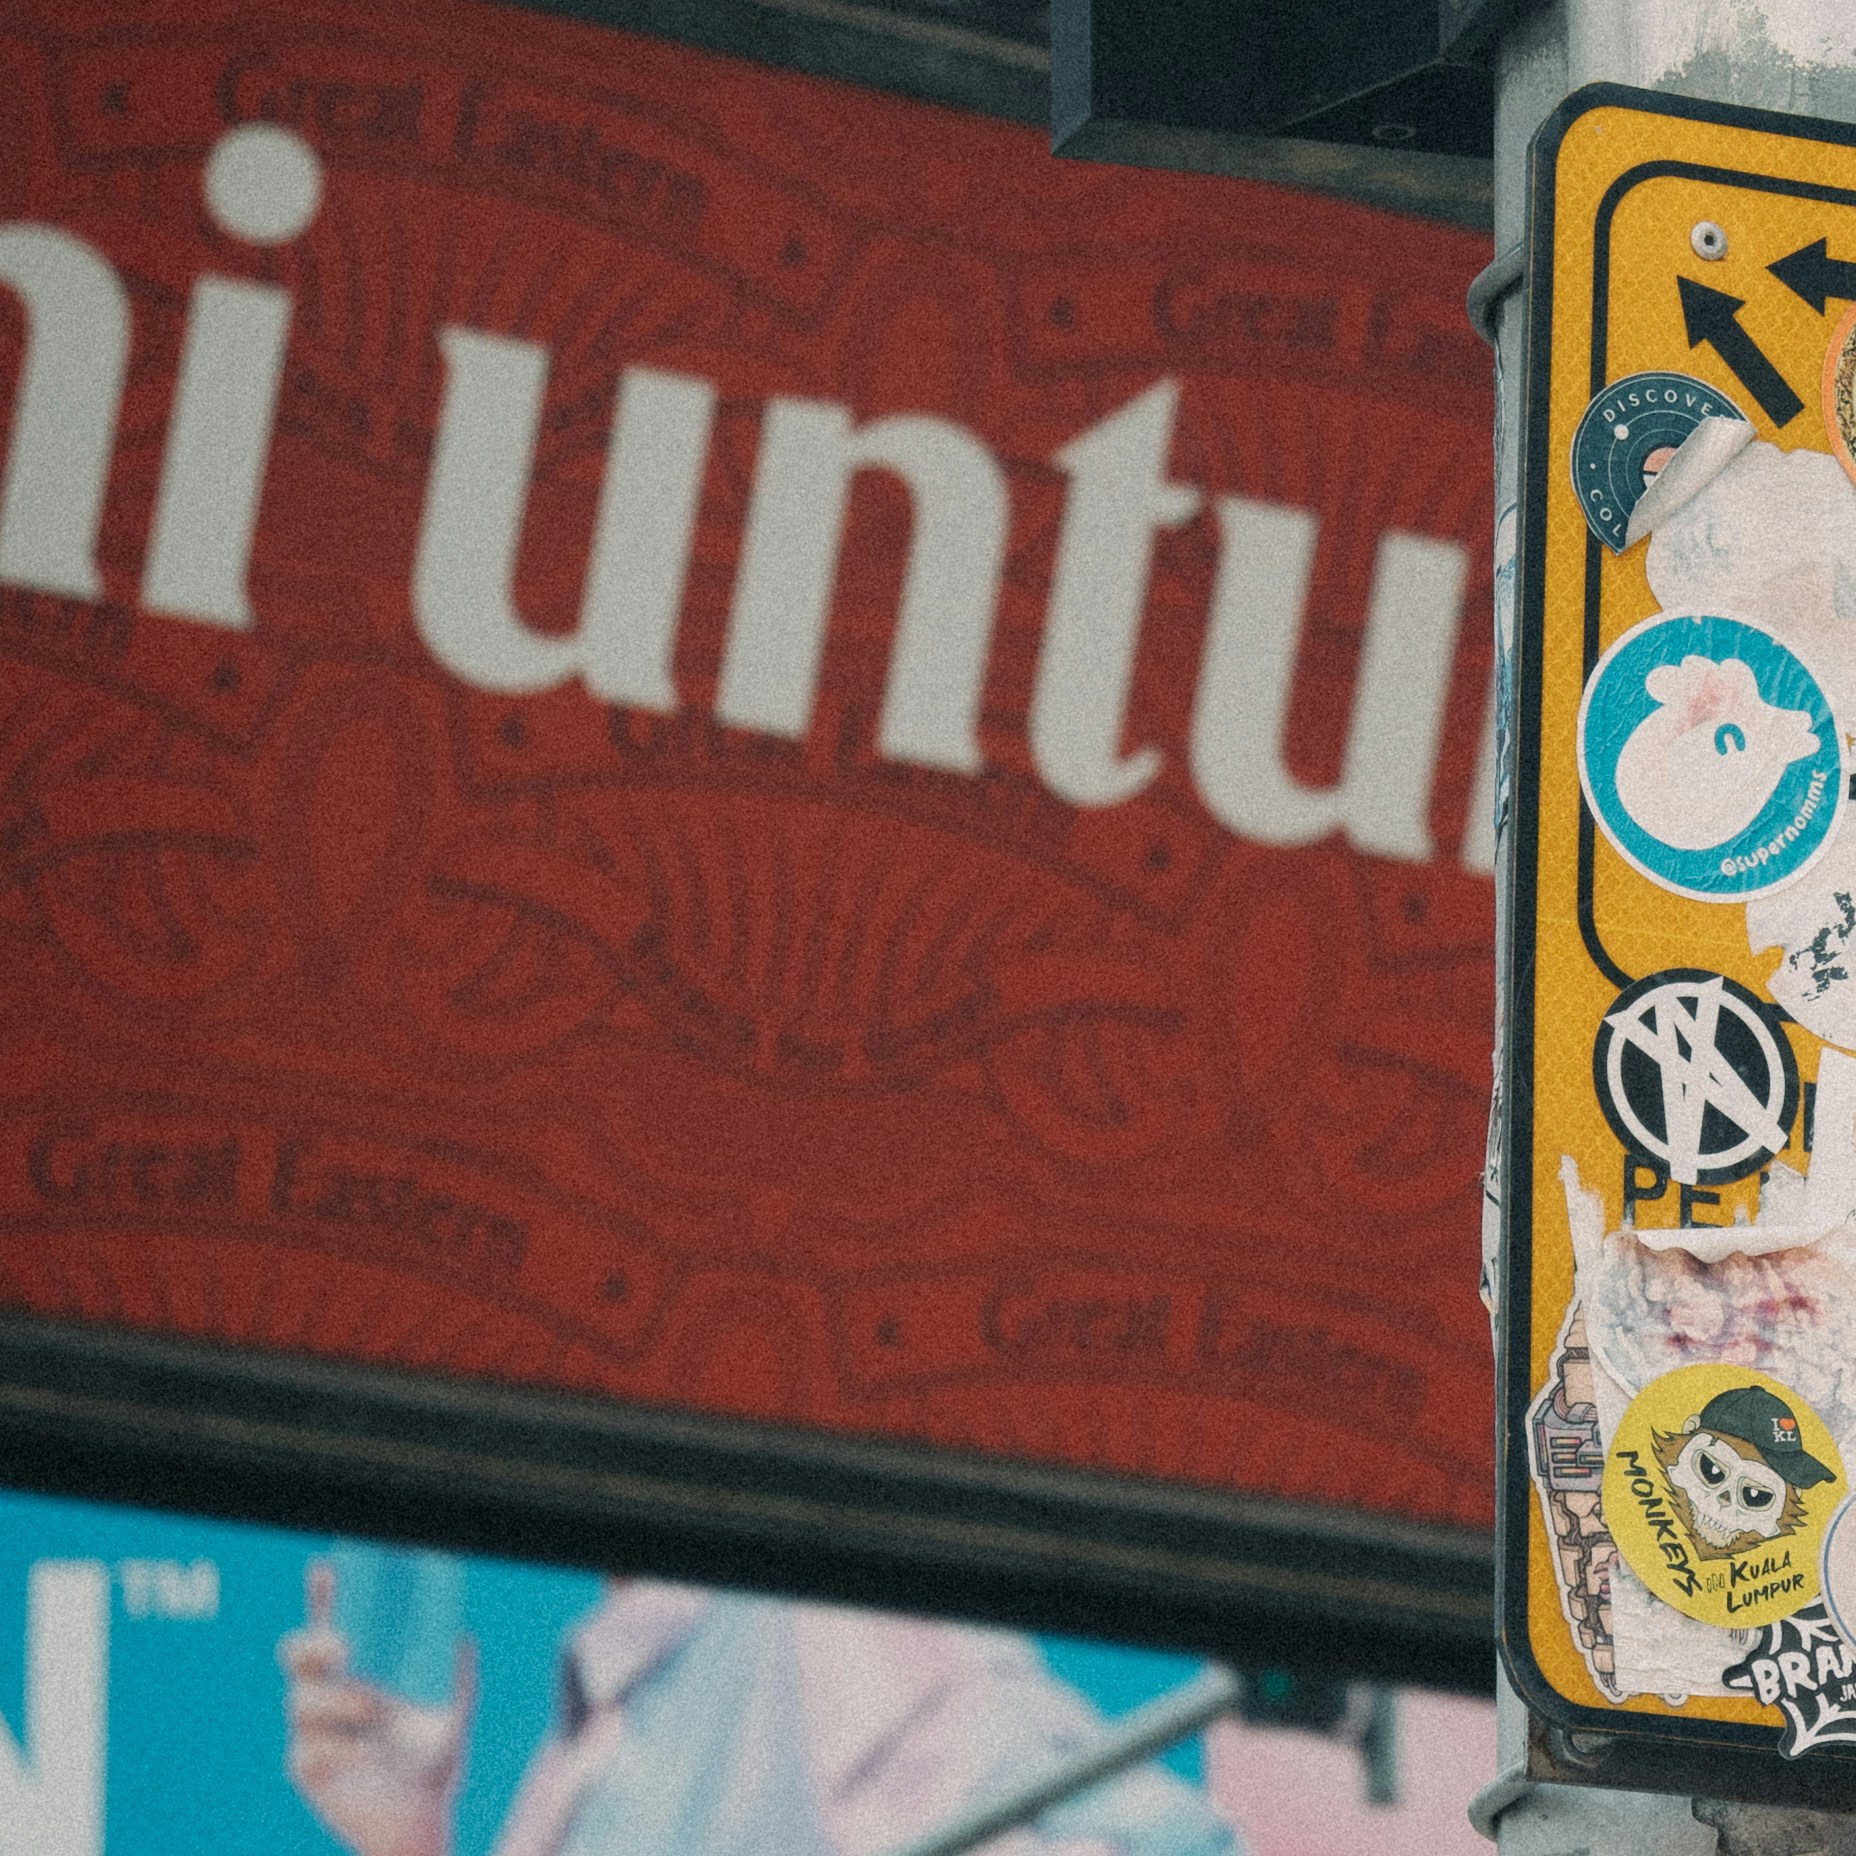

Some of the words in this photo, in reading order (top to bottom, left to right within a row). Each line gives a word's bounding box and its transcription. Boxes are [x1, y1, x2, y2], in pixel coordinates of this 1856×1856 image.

[1602, 388, 1715, 423] DISCOVE
[412, 327, 1494, 879] untu
[1720, 769, 1827, 876] @supernomms
[1772, 1430, 1797, 1443] KL
[1616, 1451, 1703, 1598] MONKEYS
[1730, 1550, 1792, 1589] KUALA
[1726, 1573, 1805, 1614] LUMPUR
